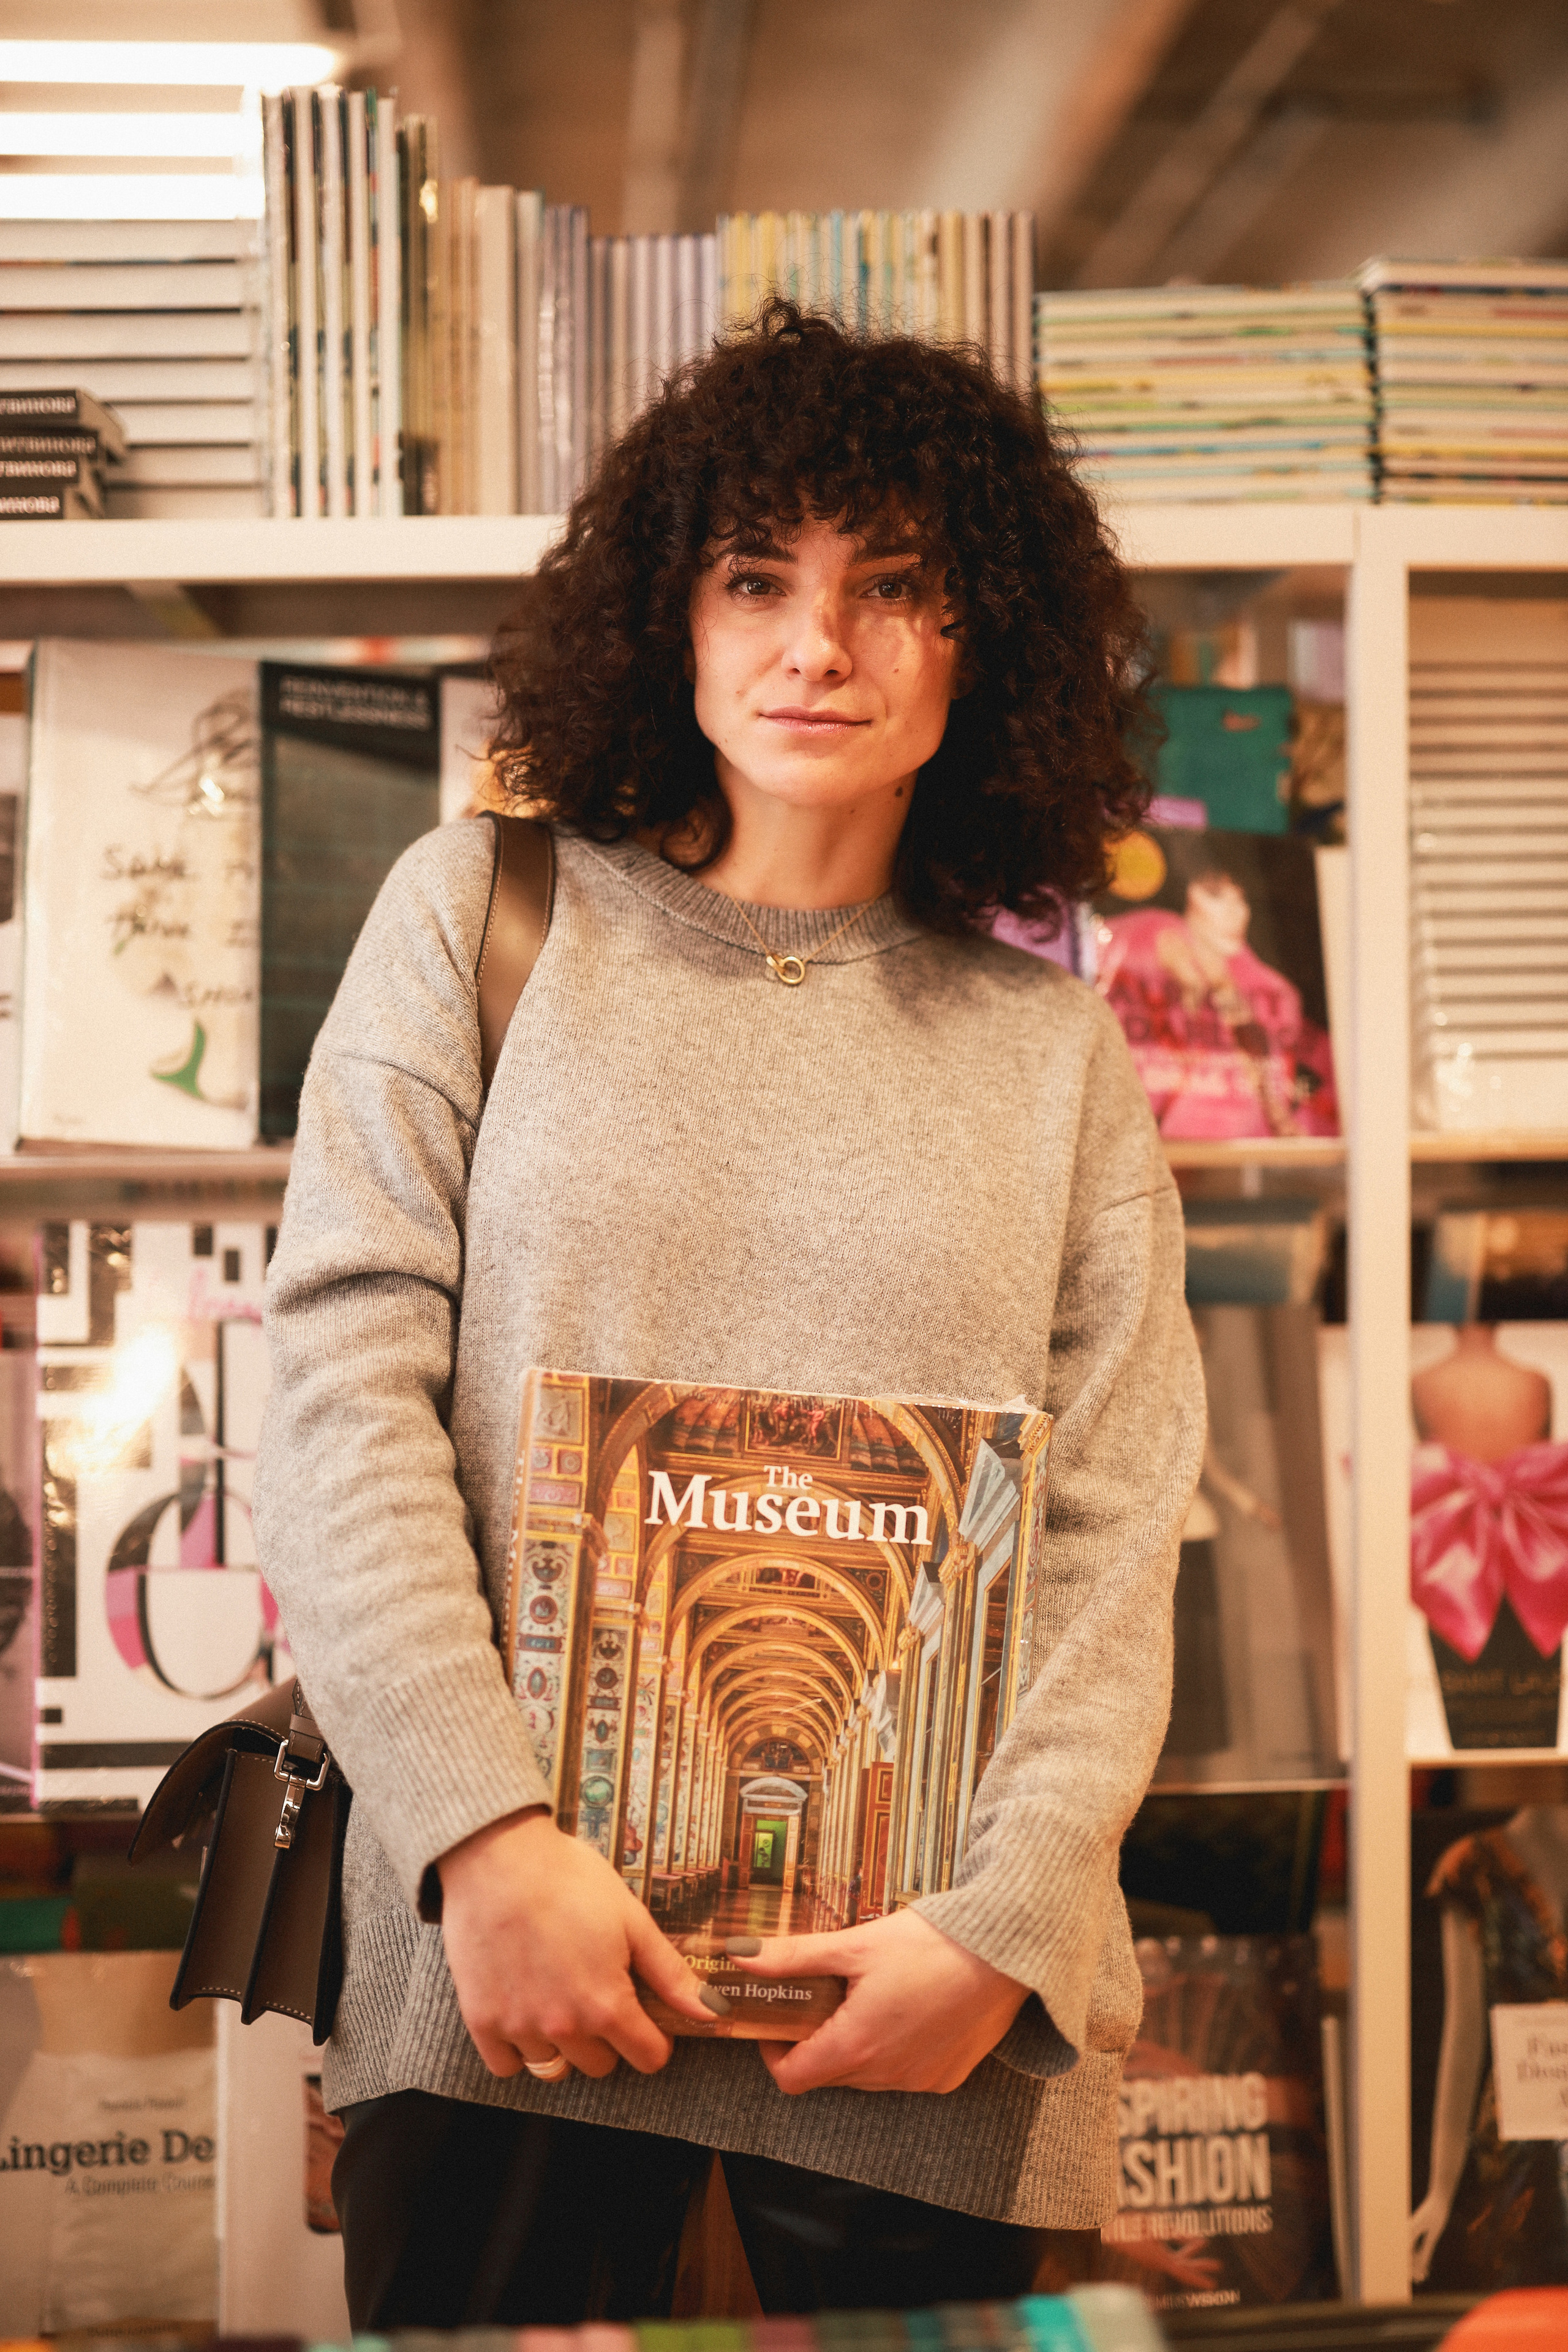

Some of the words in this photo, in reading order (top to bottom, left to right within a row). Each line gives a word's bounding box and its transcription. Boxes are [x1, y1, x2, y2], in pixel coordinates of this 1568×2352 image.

[764, 1464, 813, 1490] The
[644, 1470, 932, 1545] Museum
[684, 1954, 742, 1972] Origin
[744, 1984, 812, 2002] Hopkins
